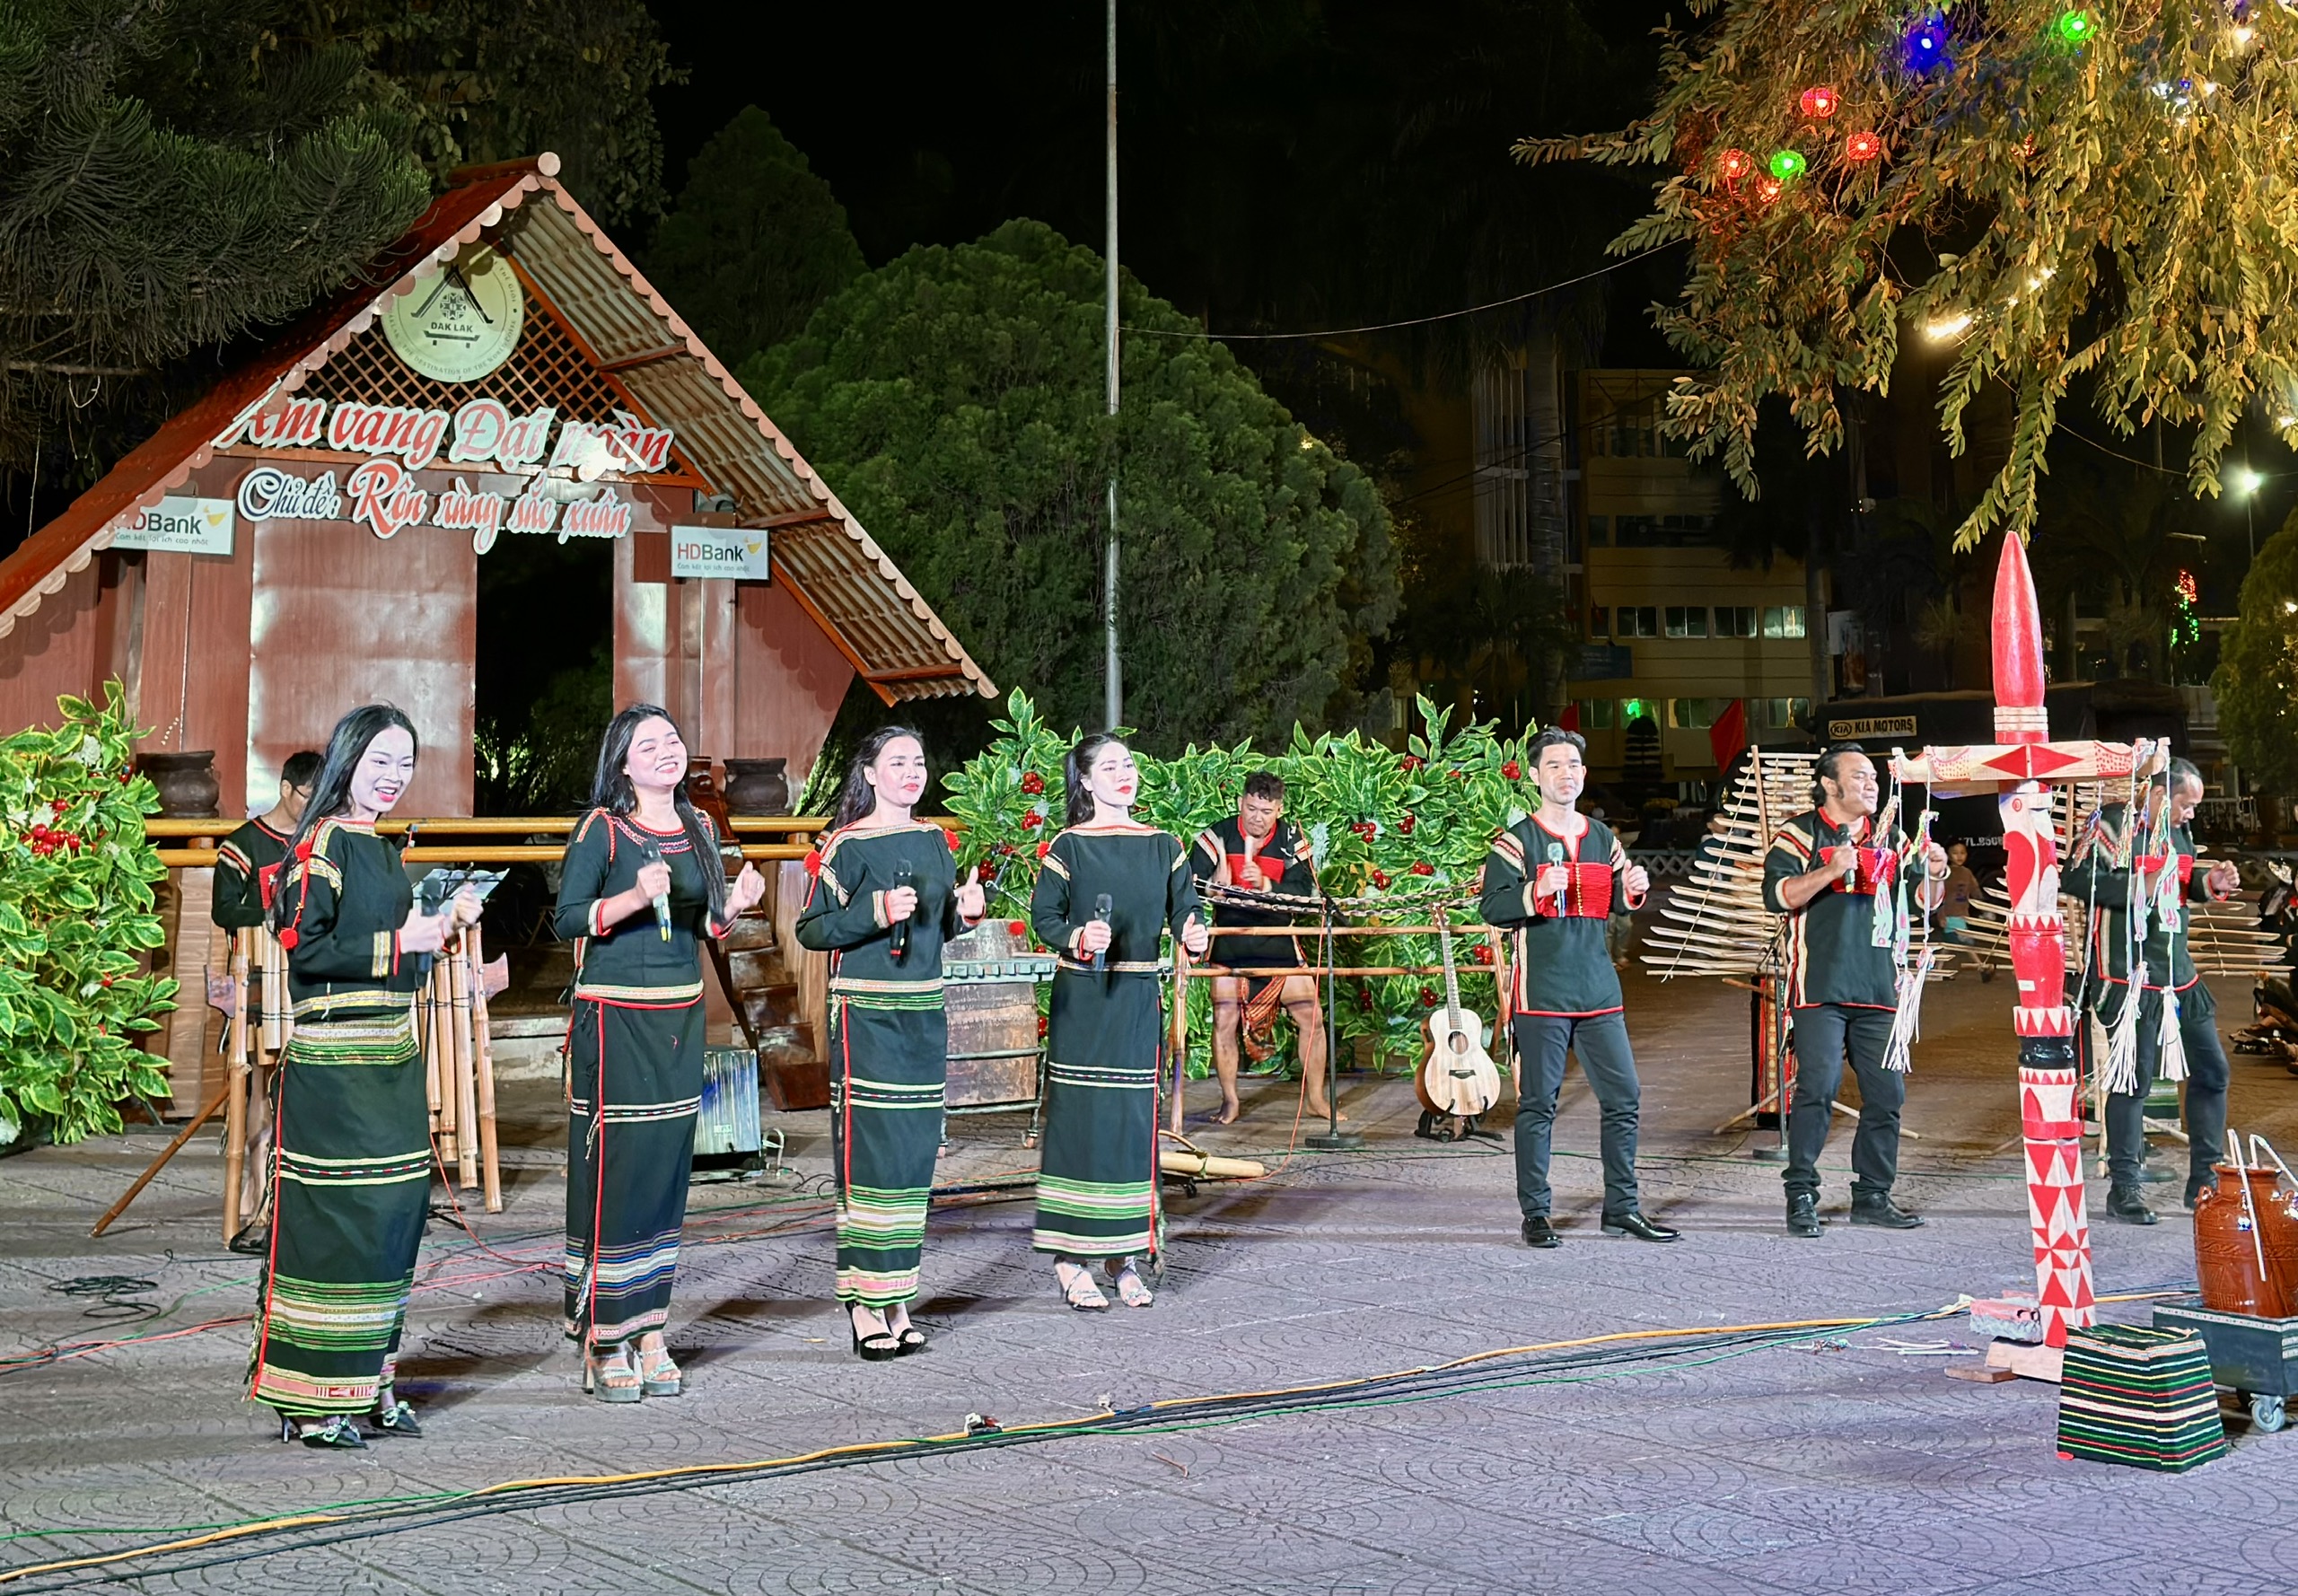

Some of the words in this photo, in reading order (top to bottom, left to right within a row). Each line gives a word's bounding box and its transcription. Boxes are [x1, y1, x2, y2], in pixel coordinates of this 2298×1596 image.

[431, 322, 452, 331] DAK
[453, 324, 473, 333] LAK
[332, 406, 445, 466] vang
[454, 403, 548, 468] Đại
[116, 512, 202, 535] DBank
[677, 542, 744, 562] HDBank
[1855, 722, 1871, 733] KIA
[1873, 718, 1913, 732] MOTORS
